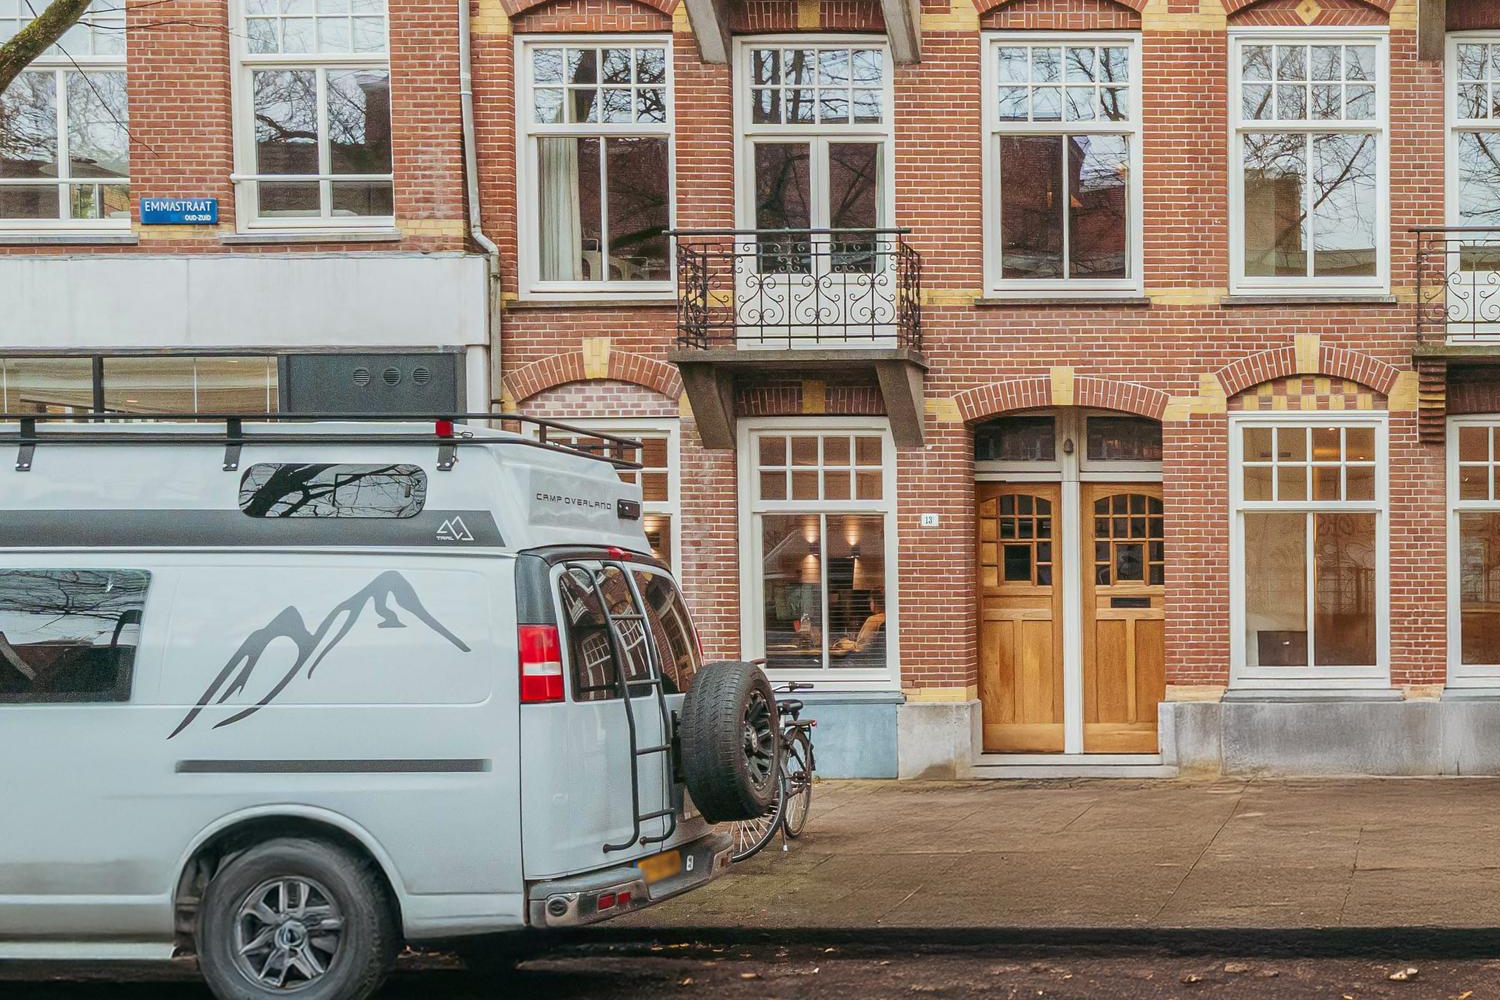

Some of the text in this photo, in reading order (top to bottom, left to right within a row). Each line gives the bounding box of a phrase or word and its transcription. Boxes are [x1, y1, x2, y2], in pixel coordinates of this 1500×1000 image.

[145, 201, 212, 212] EMMASTRAAT
[536, 493, 612, 510] CAMP OVERLAND
[925, 516, 933, 524] 13
